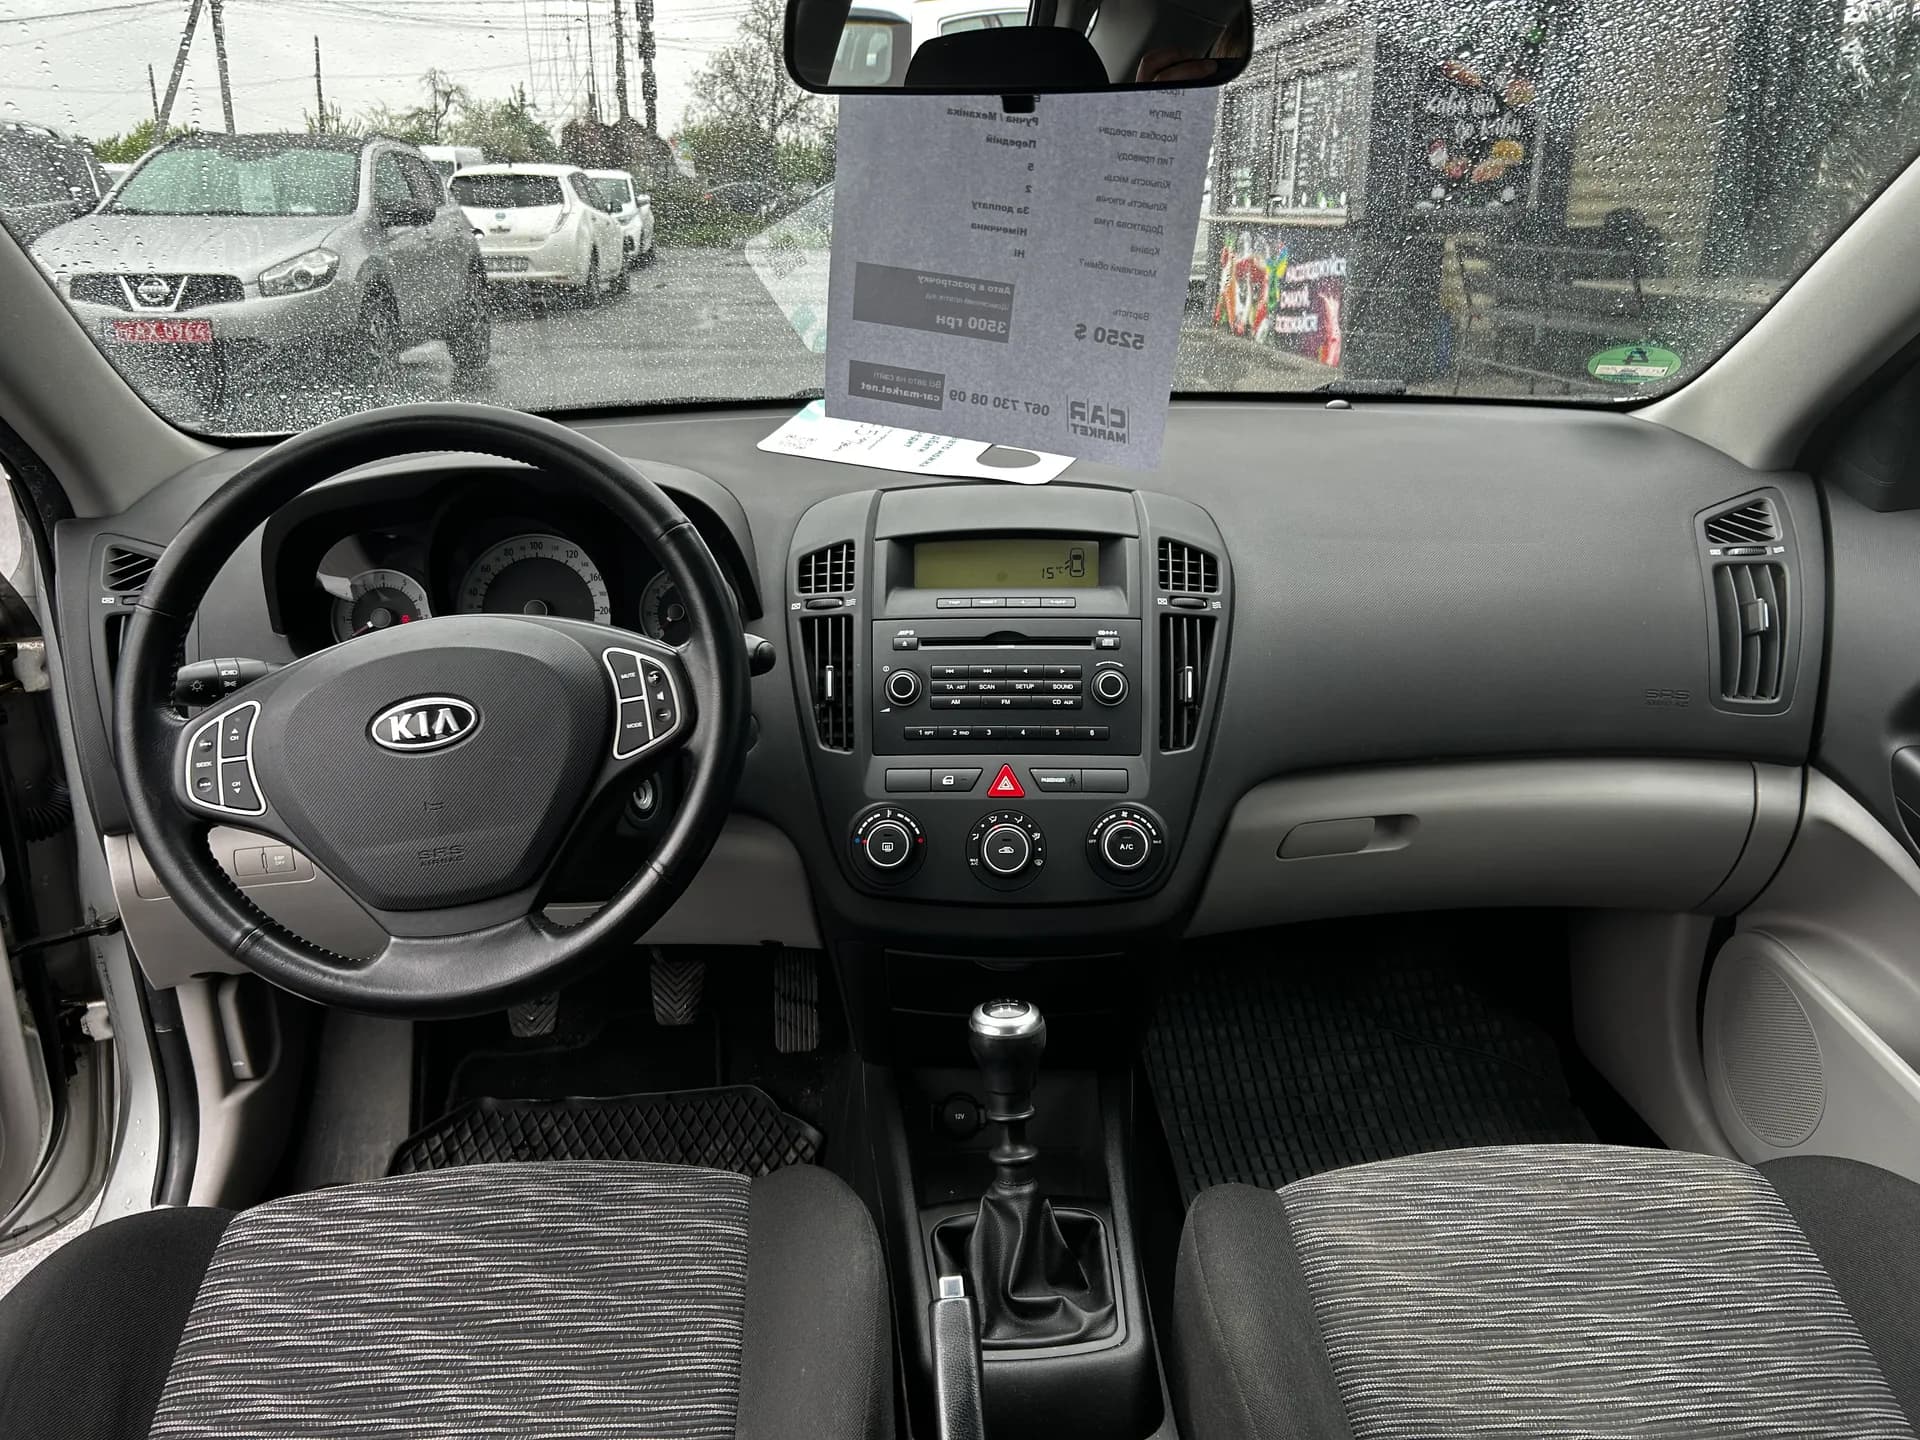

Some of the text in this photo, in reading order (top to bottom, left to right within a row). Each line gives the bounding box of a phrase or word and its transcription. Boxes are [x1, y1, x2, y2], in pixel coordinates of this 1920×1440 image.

[530, 541, 543, 550] 100
[565, 550, 579, 559] 120
[388, 707, 460, 742] KIA
[1119, 843, 1134, 851] A/C
